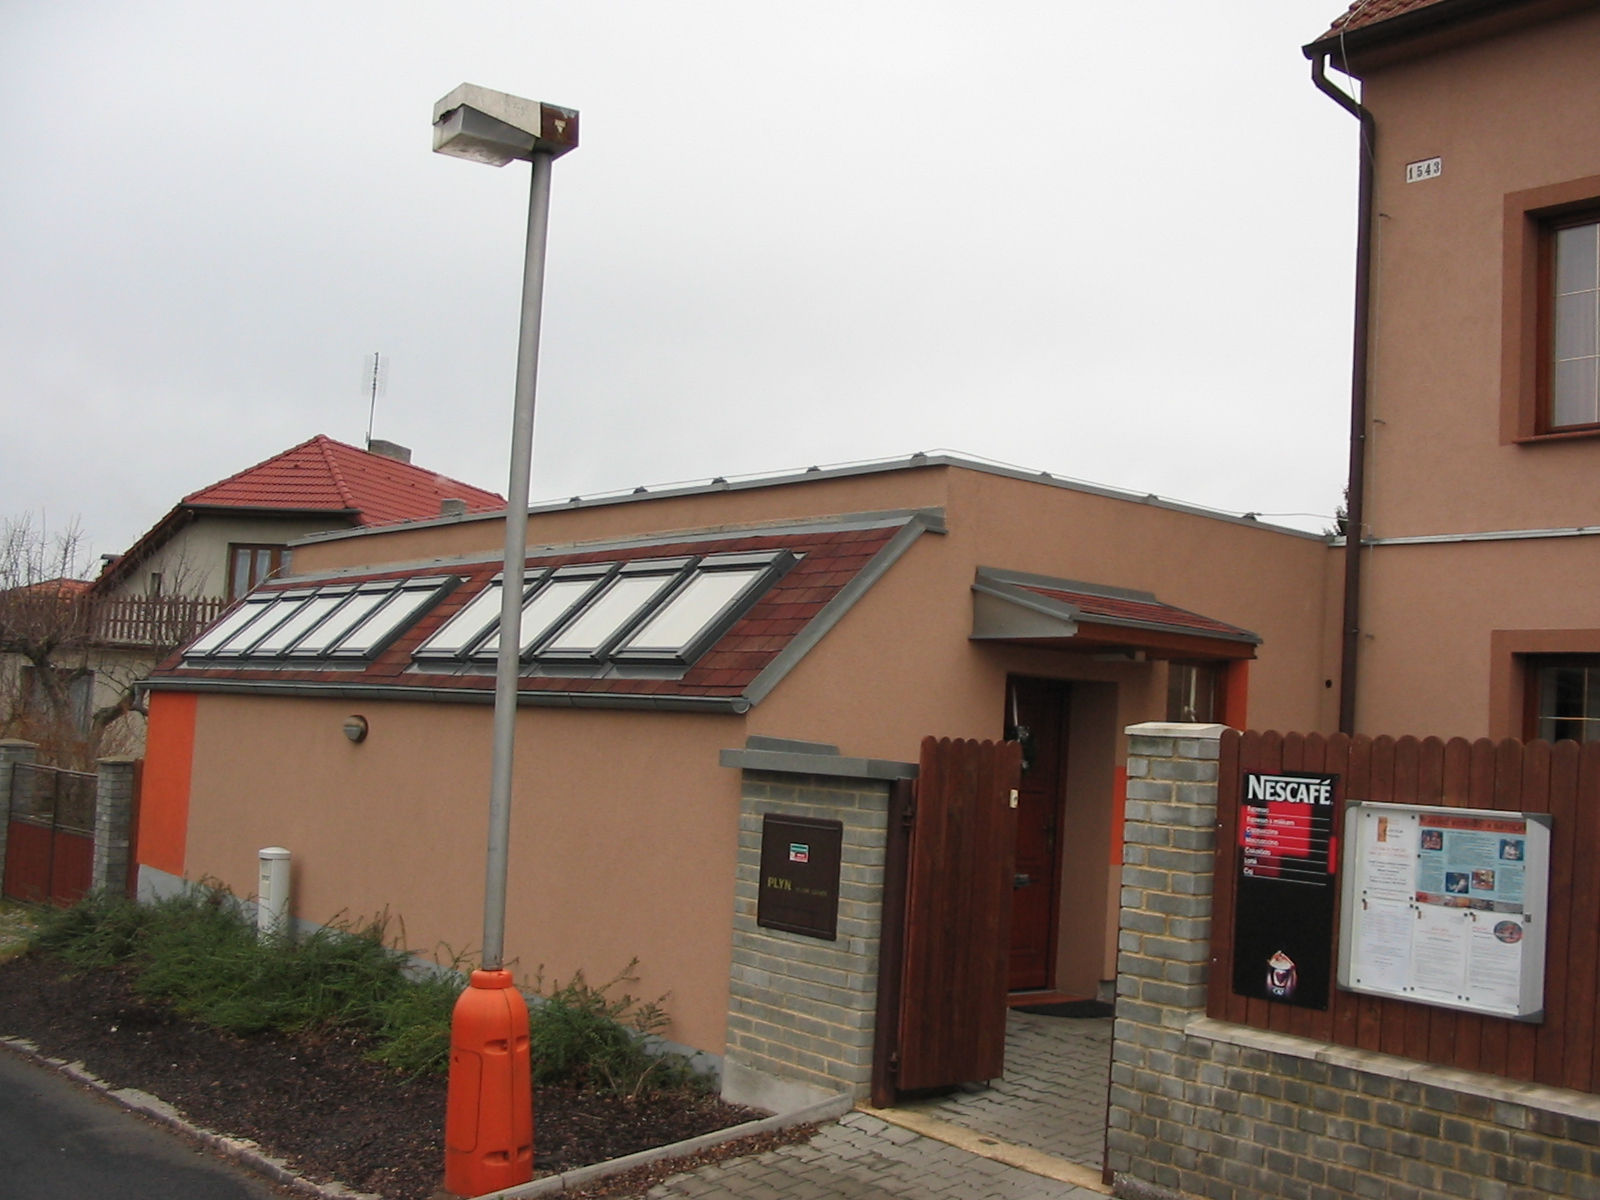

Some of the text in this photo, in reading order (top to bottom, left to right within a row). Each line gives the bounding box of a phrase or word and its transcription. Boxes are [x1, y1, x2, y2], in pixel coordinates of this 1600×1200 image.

[1409, 161, 1440, 180] 1543
[1247, 774, 1332, 806] NESCAFÉ
[768, 877, 791, 890] PLYN
